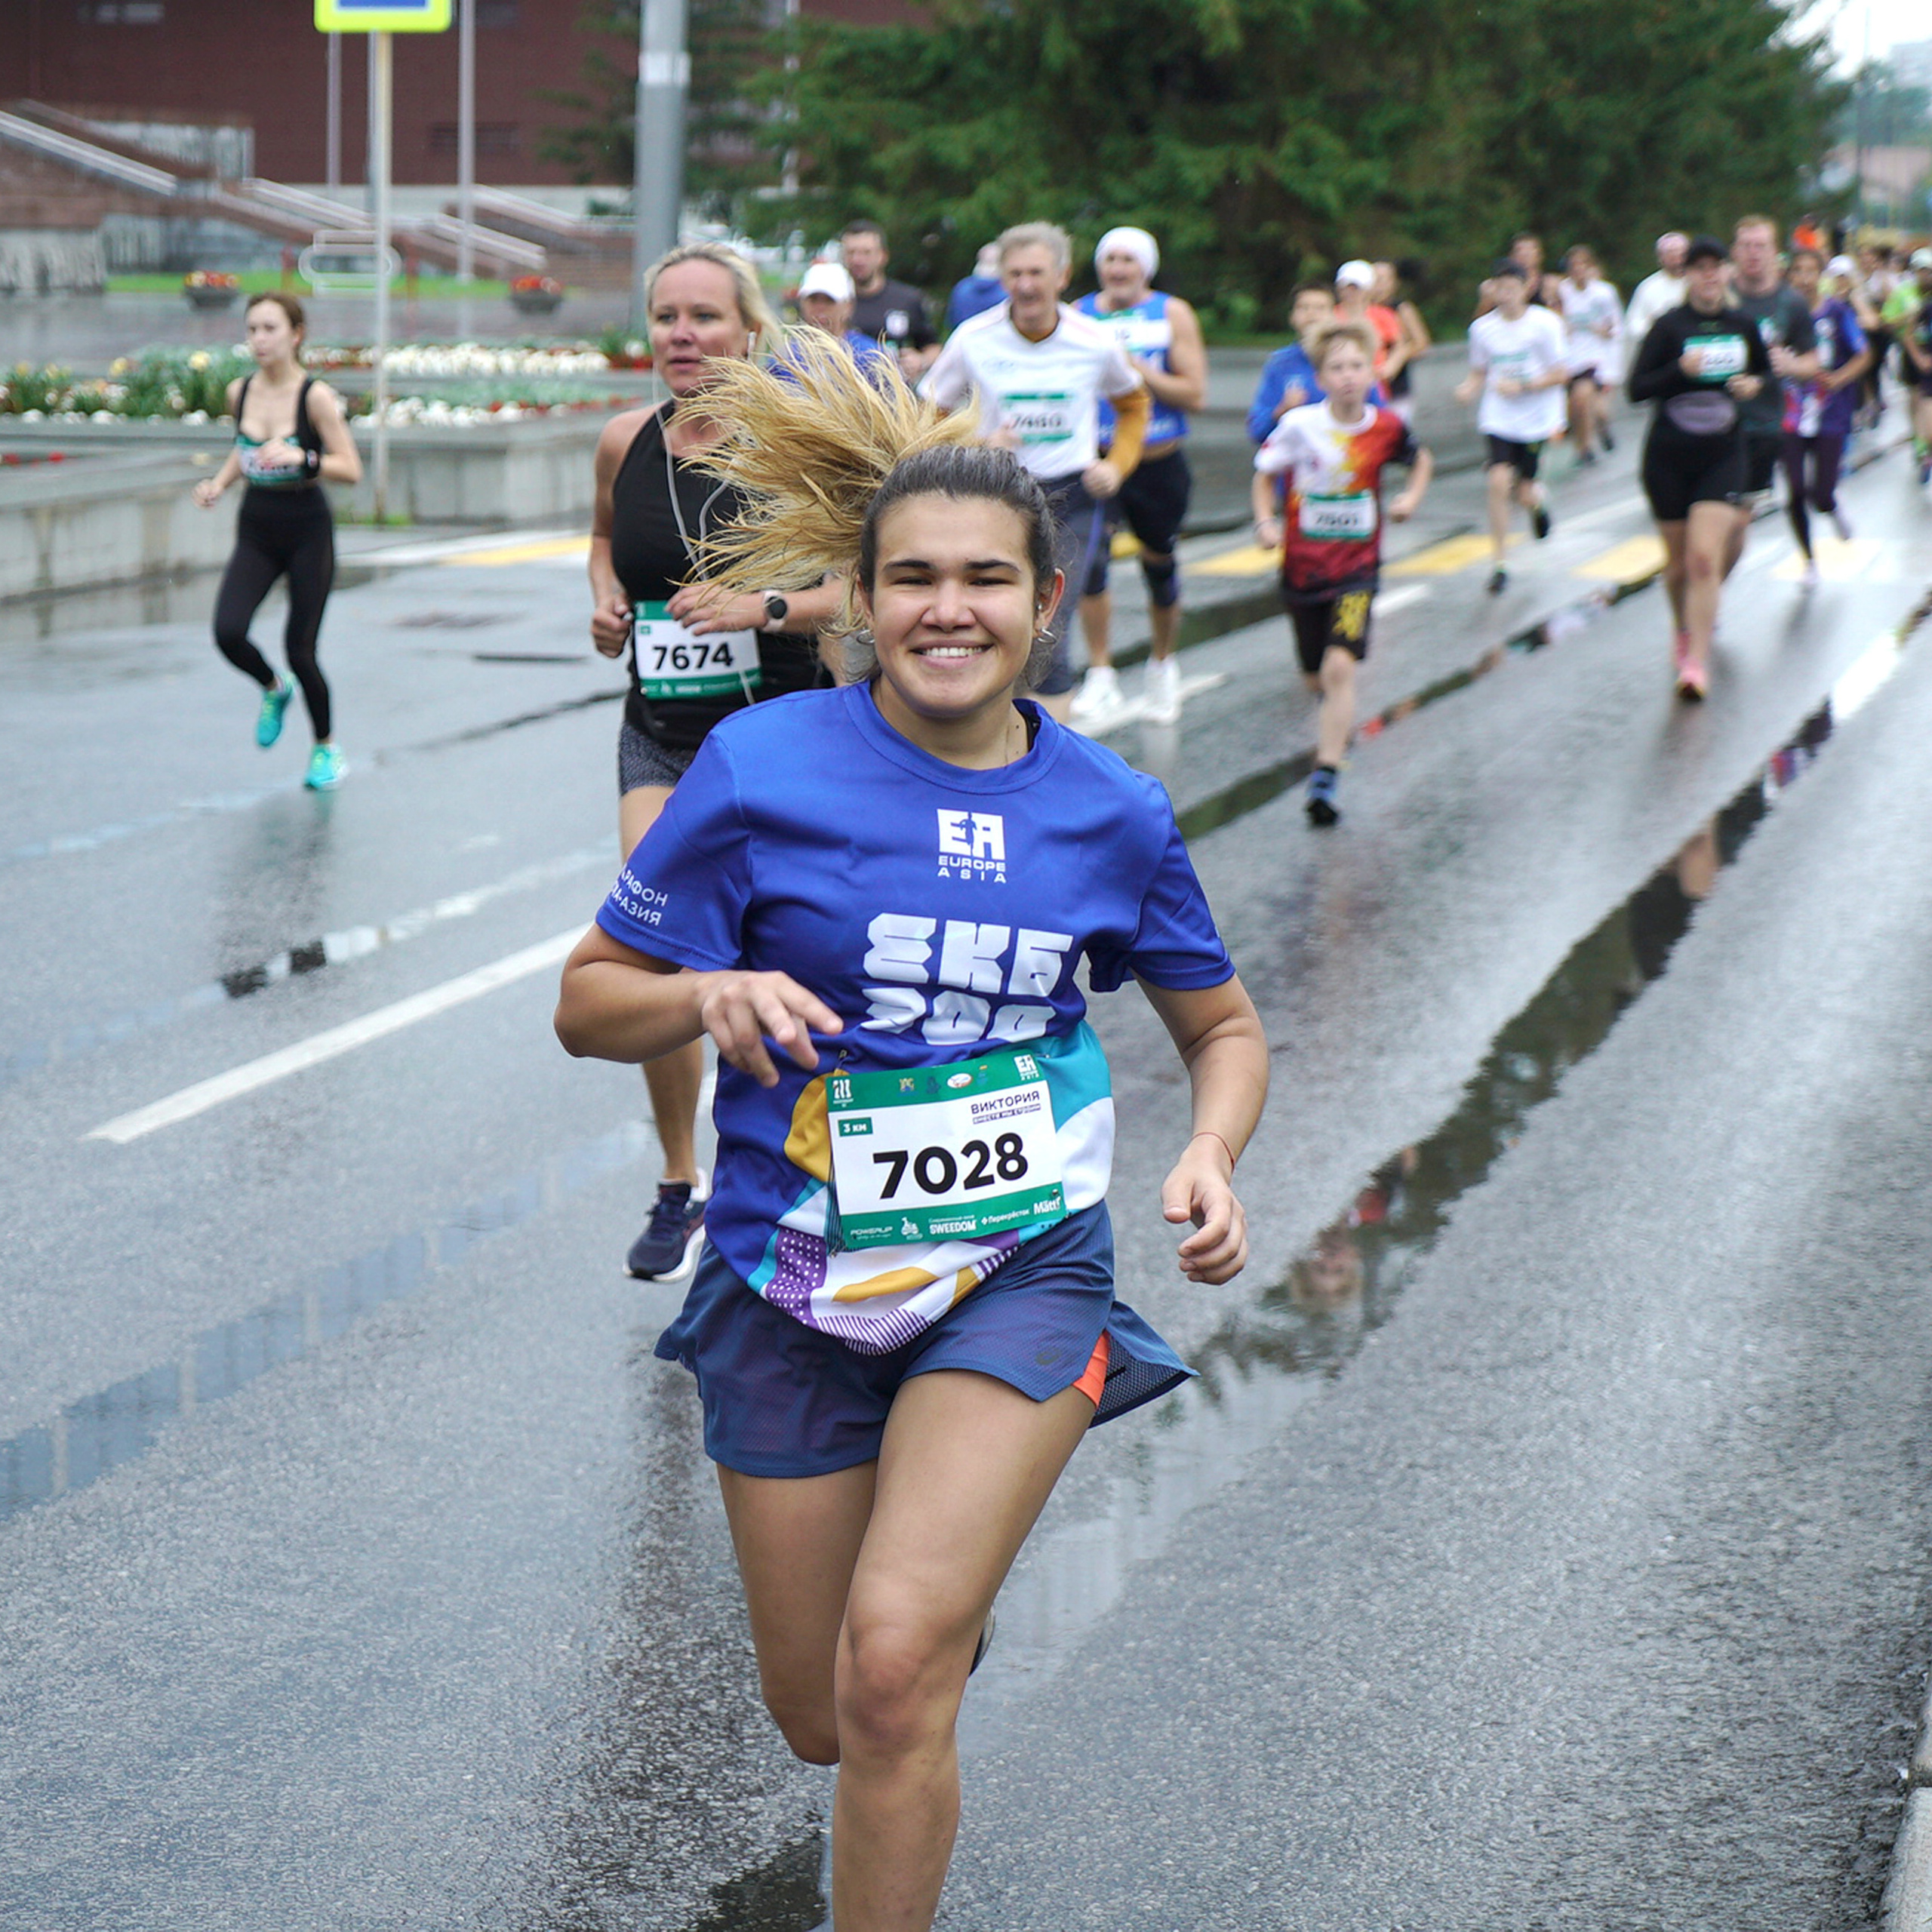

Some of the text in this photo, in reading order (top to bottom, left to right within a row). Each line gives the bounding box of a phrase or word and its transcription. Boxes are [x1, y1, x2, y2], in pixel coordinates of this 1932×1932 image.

[653, 642, 734, 671] 7674
[937, 854, 1007, 872] EUROPE
[937, 866, 1007, 884] ASIA
[970, 1090, 1040, 1115] ВИКТОРИЯ
[842, 1123, 851, 1133] 3
[872, 1132, 1029, 1200] 7028
[929, 1220, 977, 1235] SWEEDOM
